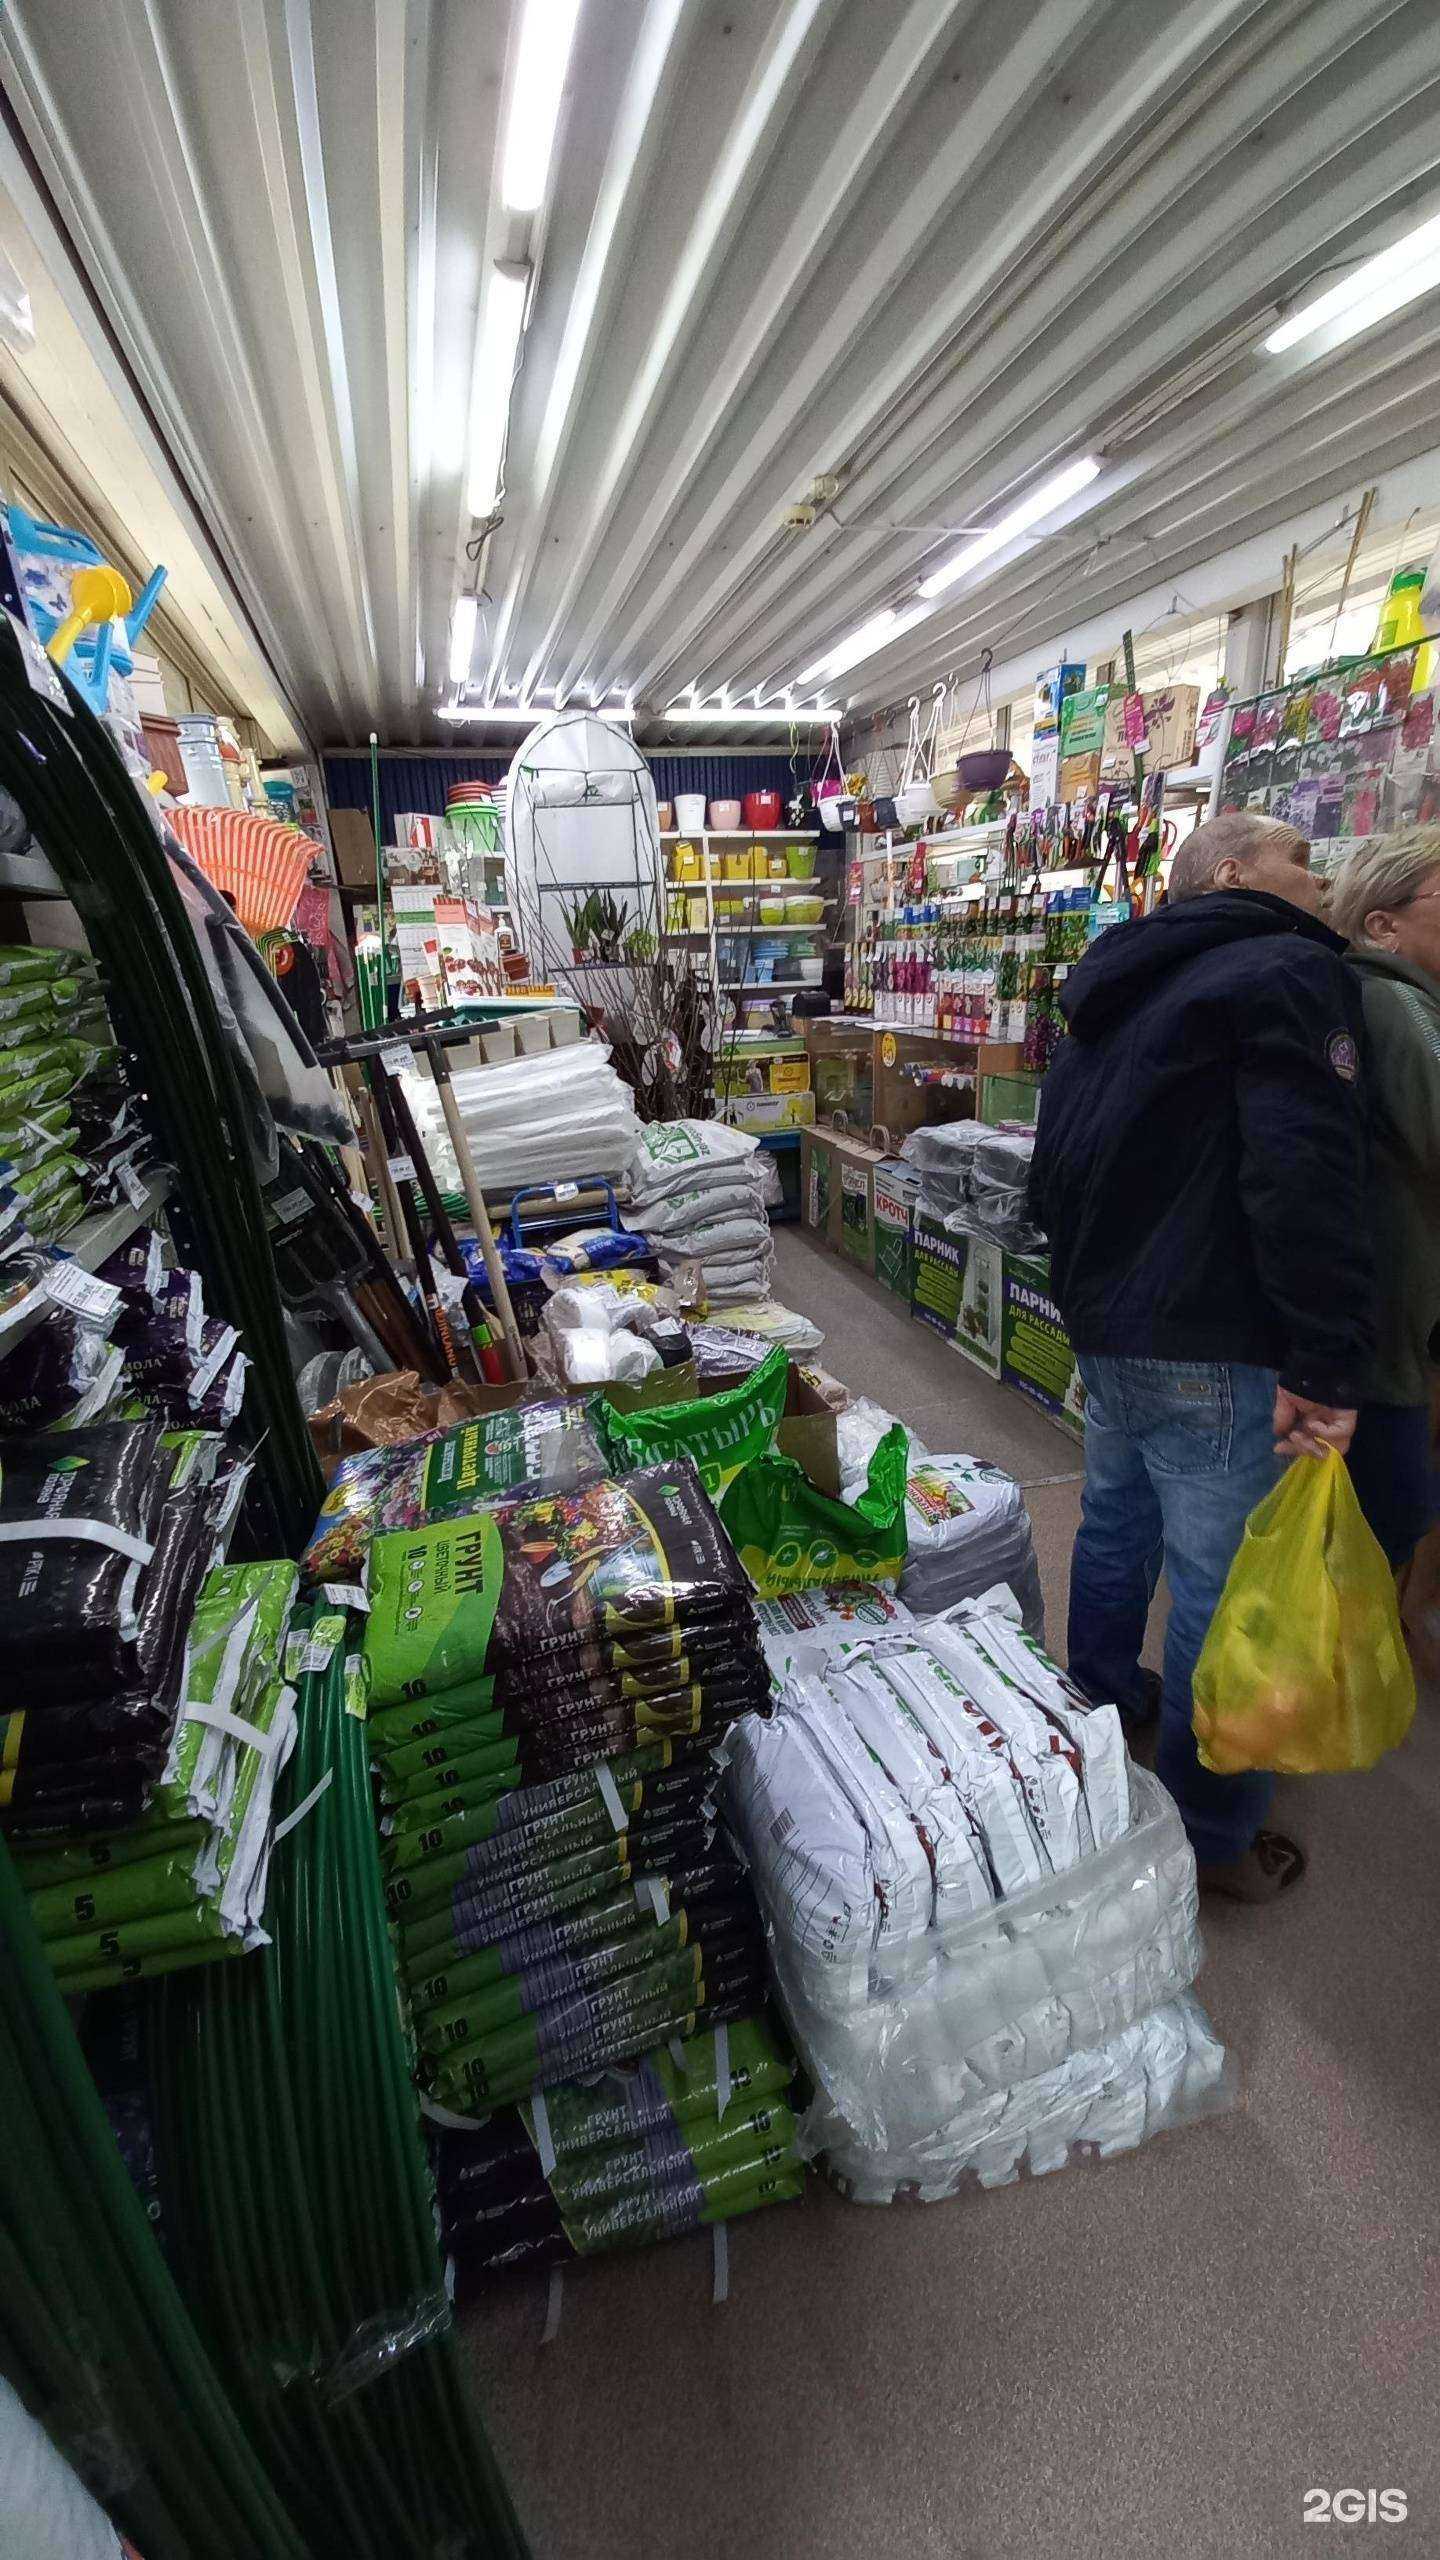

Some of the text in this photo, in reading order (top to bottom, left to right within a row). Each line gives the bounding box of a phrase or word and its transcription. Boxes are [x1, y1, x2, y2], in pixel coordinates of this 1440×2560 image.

[914, 1229, 959, 1265] ПАРНИК
[1008, 1304, 1027, 1322] ДЛЯ
[1009, 1282, 1064, 1325] ПАРНИ
[456, 1424, 480, 1490] Цветочный
[705, 1473, 717, 1488] 1
[407, 1545, 428, 1560] 10
[455, 1530, 483, 1595] ГРУНТ
[433, 1539, 452, 1595] ЦВЕТОЧНЫЙ
[540, 1629, 586, 1651] ГРУНТ
[547, 1668, 592, 1688] ГРУНТ
[557, 1695, 602, 1717] ГРУНТ
[570, 1721, 616, 1741] ГРУНТ
[573, 1745, 618, 1767] ГРУНТ
[521, 1768, 638, 1819] УНИВЕРСАЛЫЙ
[524, 1812, 566, 1837] ГРУНТ
[418, 1827, 444, 1852] 10
[508, 1867, 550, 1893] ГРУНТ
[73, 1894, 95, 1921] 5
[515, 1894, 555, 1918] ГРУНТ
[555, 1916, 595, 1941] ГРУНТ
[100, 1930, 119, 1956] 5
[575, 1953, 615, 1978] ГРУНТ
[591, 1987, 629, 2013] ГРУНТ
[444, 2017, 469, 2042] 10
[594, 2013, 633, 2037] ГРУНТ
[463, 2057, 486, 2082] 10
[587, 2105, 627, 2127] ГРУНТ
[749, 2109, 772, 2133] 10
[553, 2109, 668, 2154] УНИВЕРСАЛЬНЫЙ
